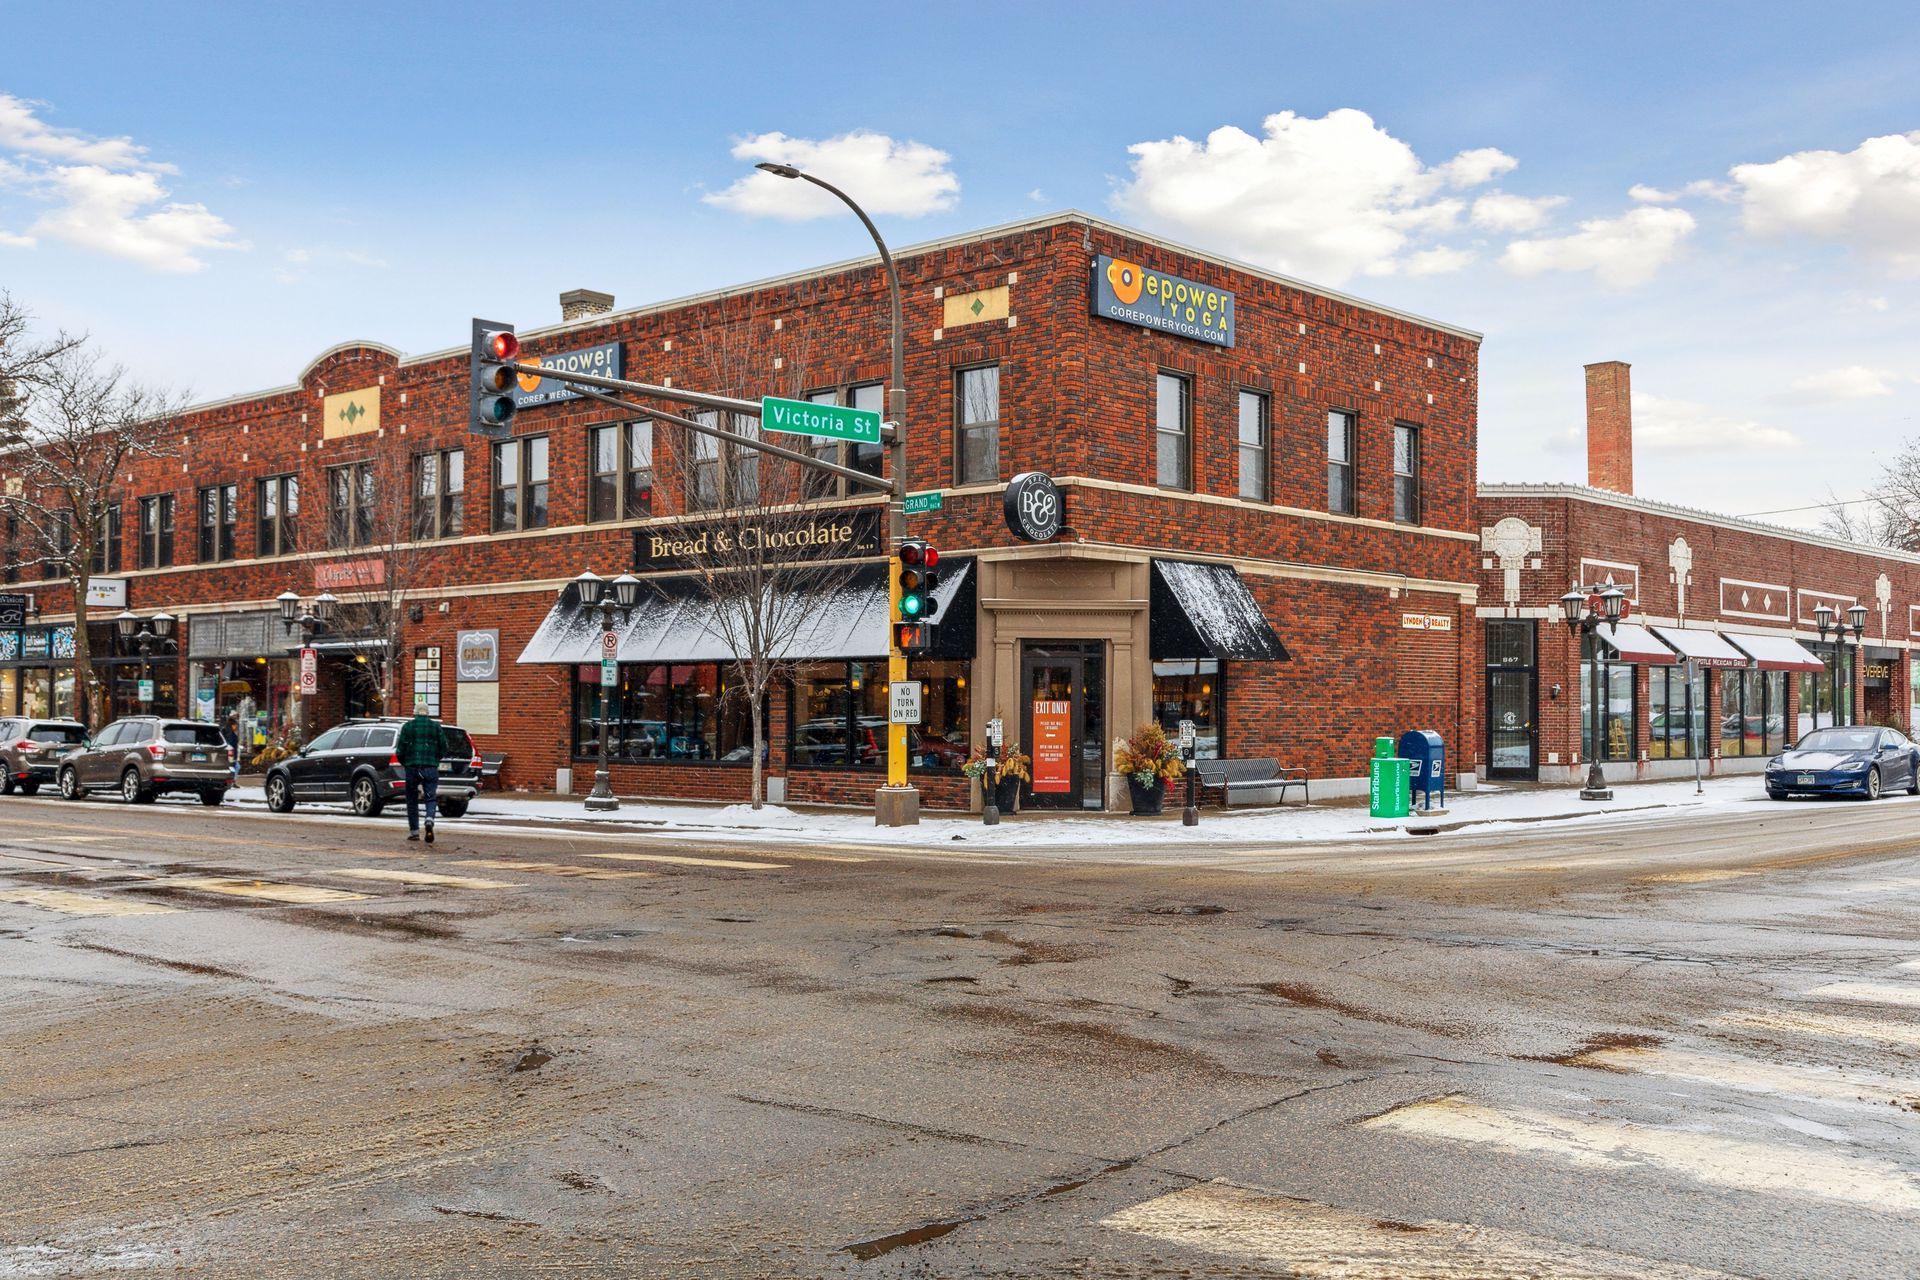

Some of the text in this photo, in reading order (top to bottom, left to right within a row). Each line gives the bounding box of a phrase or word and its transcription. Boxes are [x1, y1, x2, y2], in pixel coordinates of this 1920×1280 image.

[1170, 302, 1228, 331] YOGA
[1110, 306, 1224, 342] COREPOWERYOGA.COM
[773, 406, 871, 435] Victoria St
[905, 497, 928, 510] GRAND
[650, 522, 852, 558] Bread & Chocolate
[1431, 618, 1450, 628] REALTY
[463, 647, 491, 660] GENT
[1733, 659, 1747, 667] GRILL
[900, 687, 911, 696] NO
[897, 698, 915, 707] TURN
[1035, 701, 1068, 714] EXIT ONLY
[893, 709, 918, 718] ON RED
[1372, 761, 1380, 811] StarTribune
